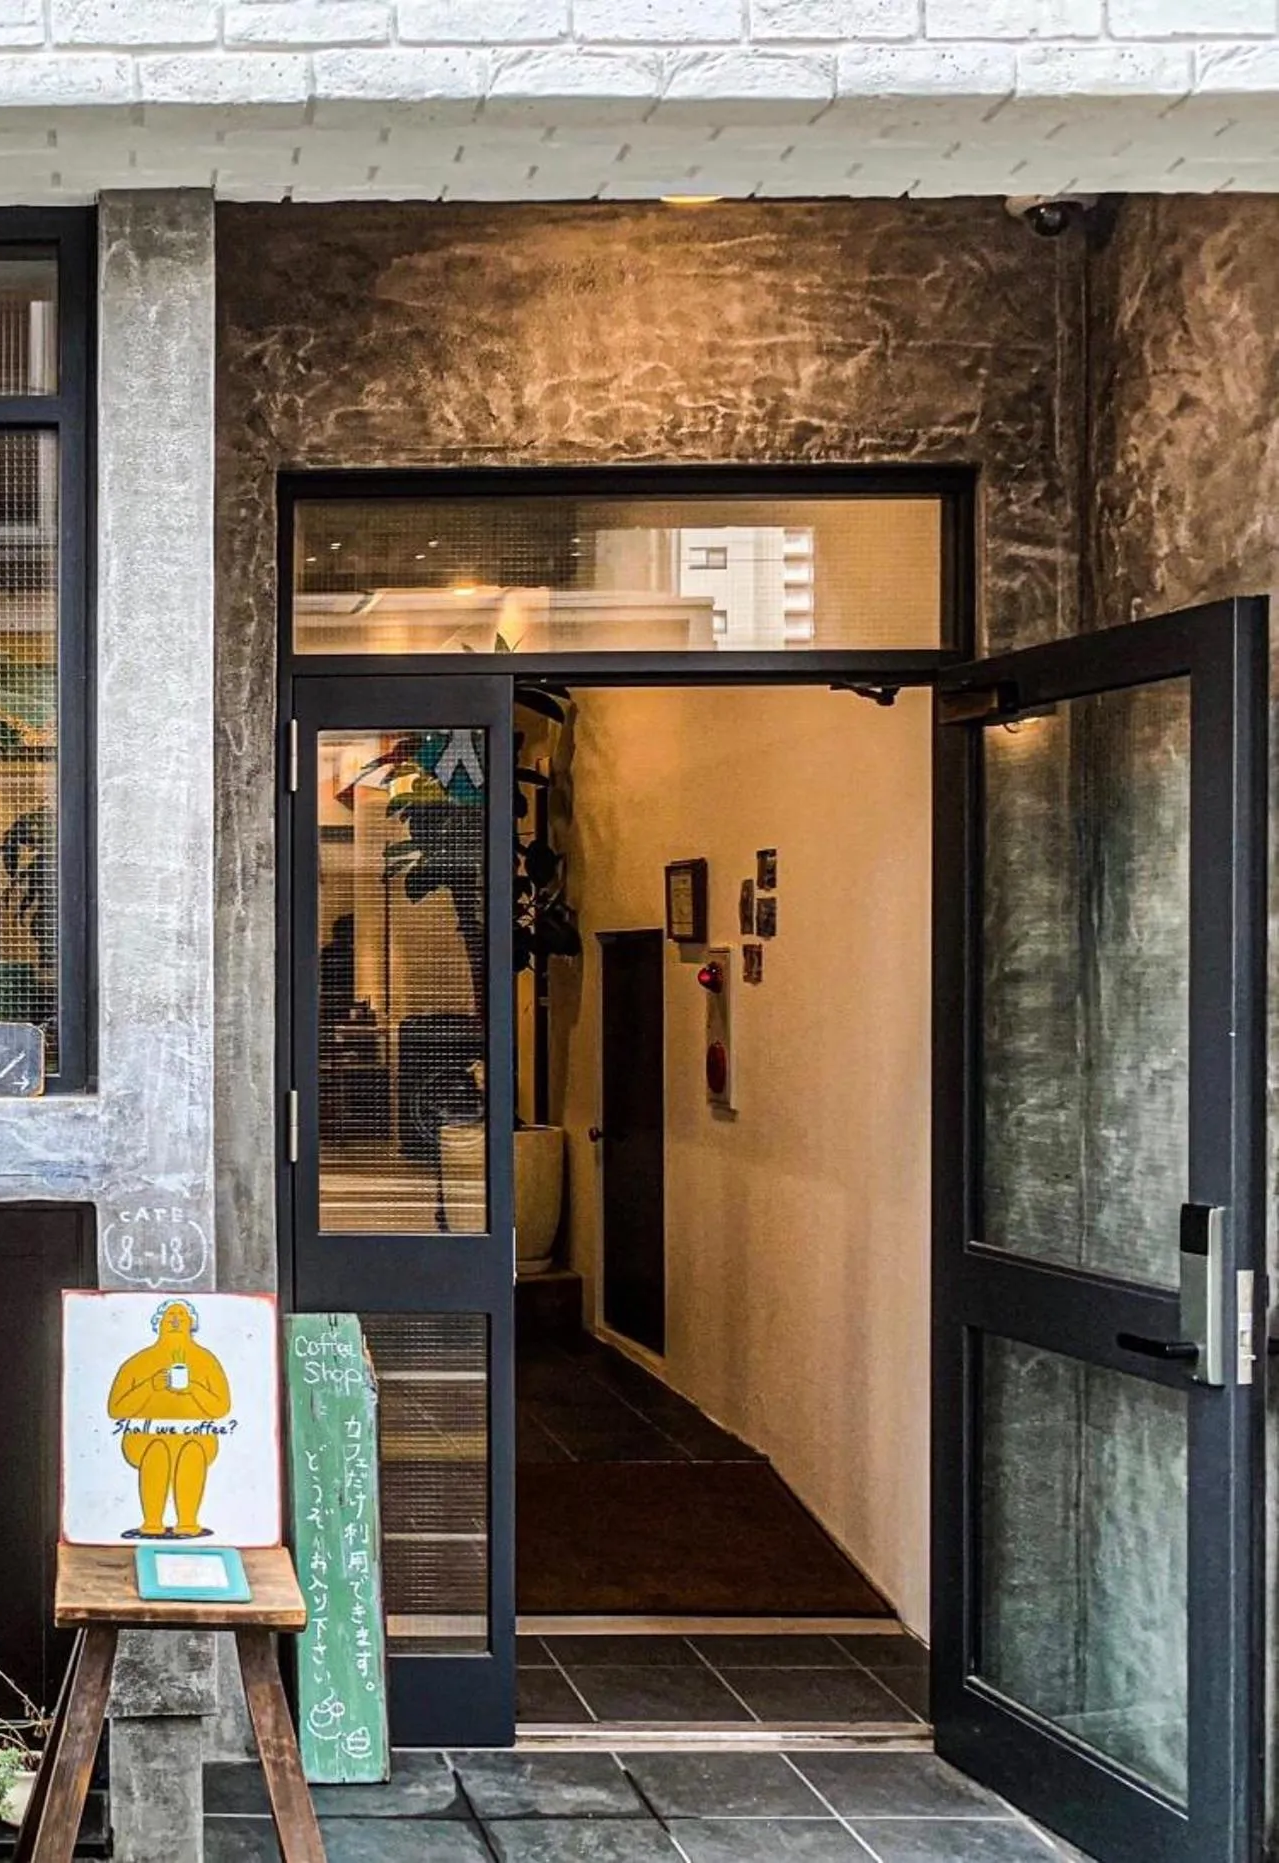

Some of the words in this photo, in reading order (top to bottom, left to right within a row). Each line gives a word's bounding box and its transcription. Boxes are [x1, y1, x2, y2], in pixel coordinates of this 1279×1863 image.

[303, 1361, 363, 1396] Shop
[112, 1418, 154, 1435] Shall
[156, 1424, 178, 1434] we
[183, 1419, 239, 1435] coffee?
